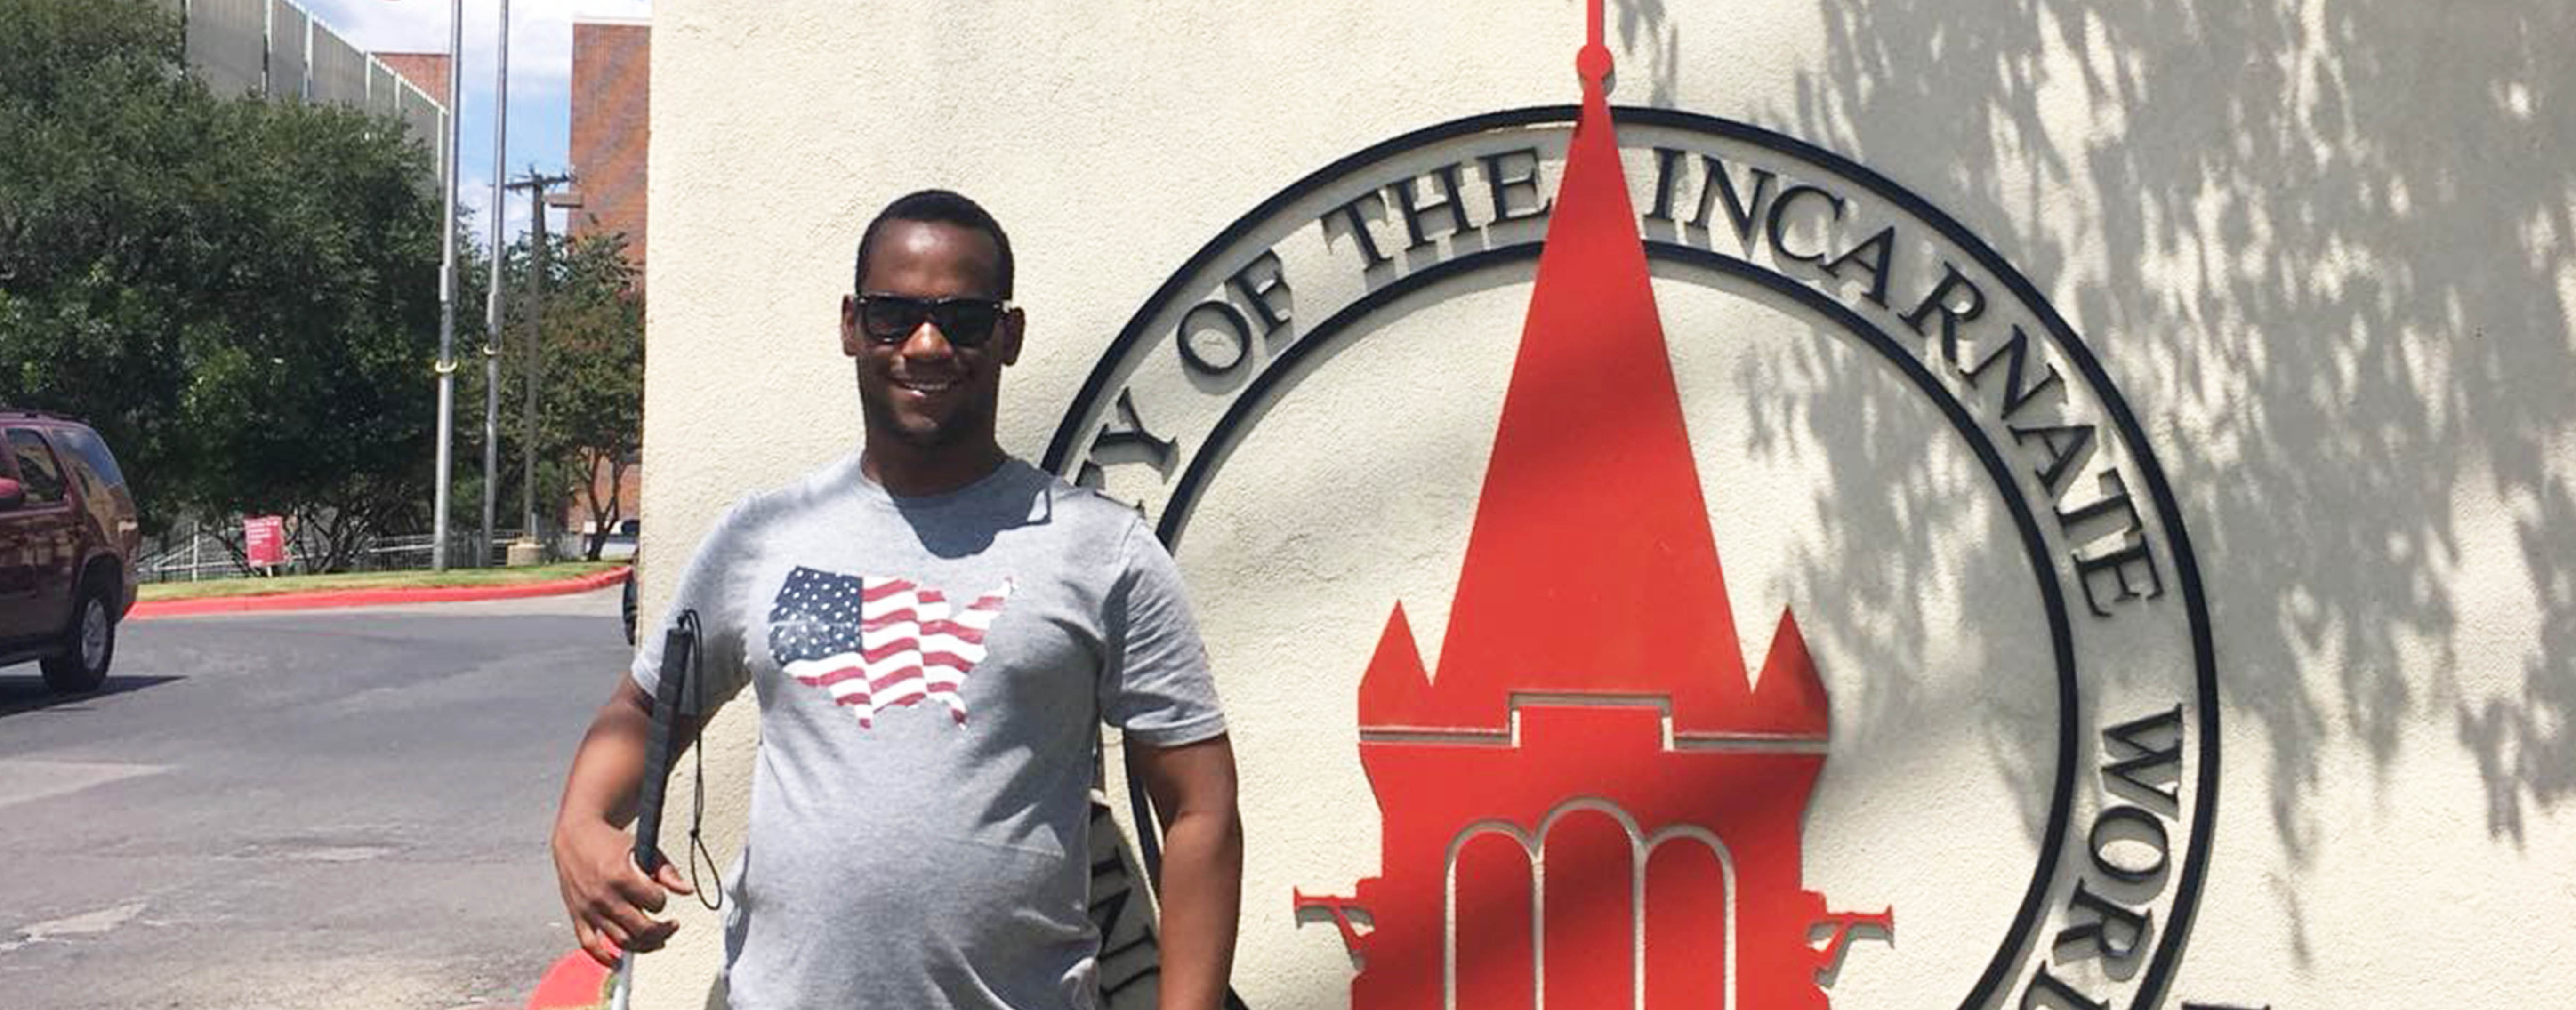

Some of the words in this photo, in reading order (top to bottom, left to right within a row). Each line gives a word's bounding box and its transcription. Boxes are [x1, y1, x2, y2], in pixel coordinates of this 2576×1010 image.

[1176, 248, 1291, 375] OF
[1320, 147, 1553, 271] THE
[1644, 147, 2165, 618] INCARNATE
